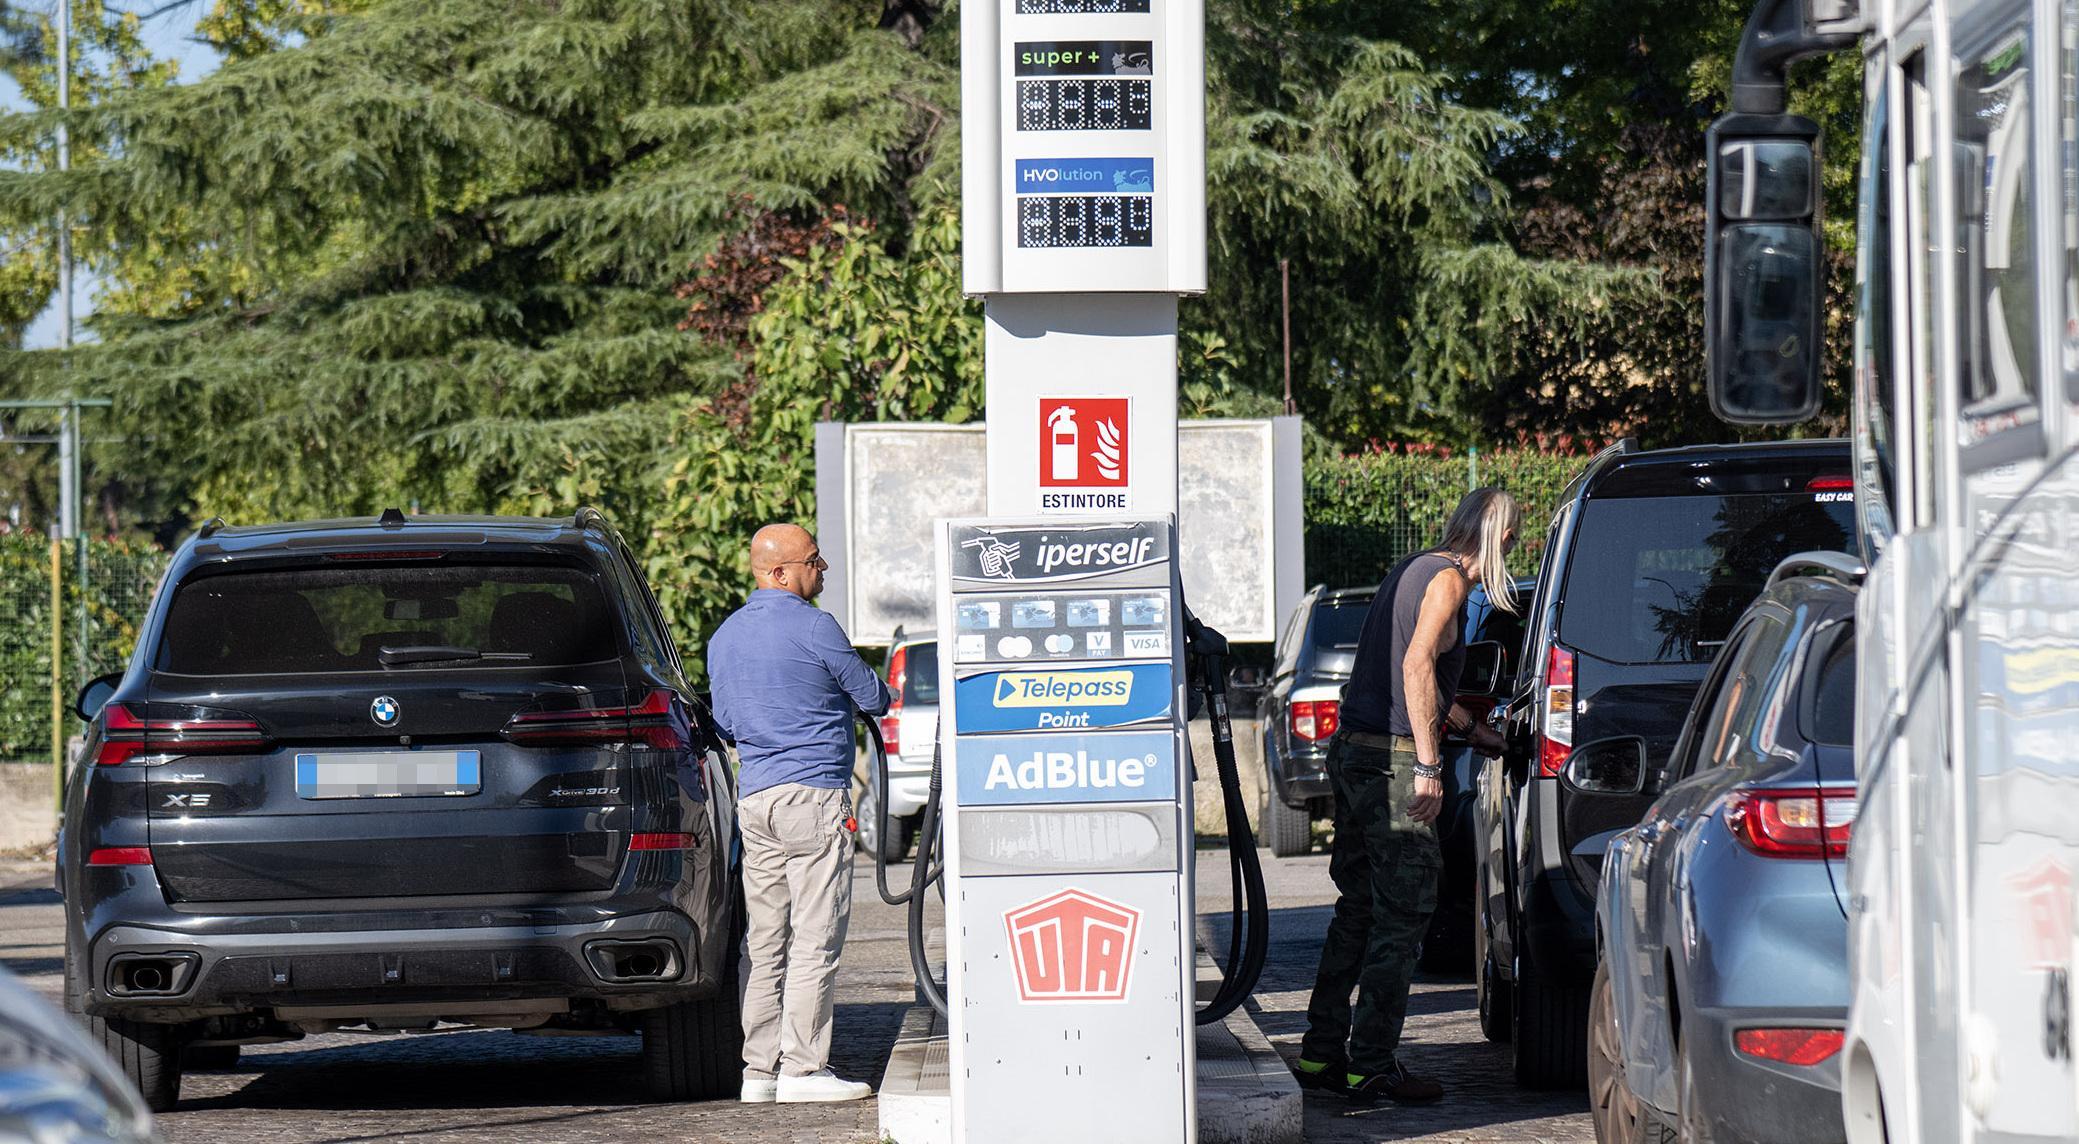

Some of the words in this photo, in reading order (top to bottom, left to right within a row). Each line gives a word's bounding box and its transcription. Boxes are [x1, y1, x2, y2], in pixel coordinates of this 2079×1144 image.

[1022, 51, 1082, 67] super
[1023, 168, 1103, 182] HVOlution
[1043, 494, 1126, 508] ESTINTORE
[1815, 493, 1836, 502] EASY
[1836, 493, 1854, 502] CAR
[1037, 536, 1154, 573] iperself
[1094, 635, 1104, 646] V
[1131, 638, 1161, 649] VISA
[1020, 676, 1128, 702] Telepass
[1038, 711, 1090, 728] Point
[161, 794, 211, 807] X5
[1015, 897, 1130, 993] UTA
